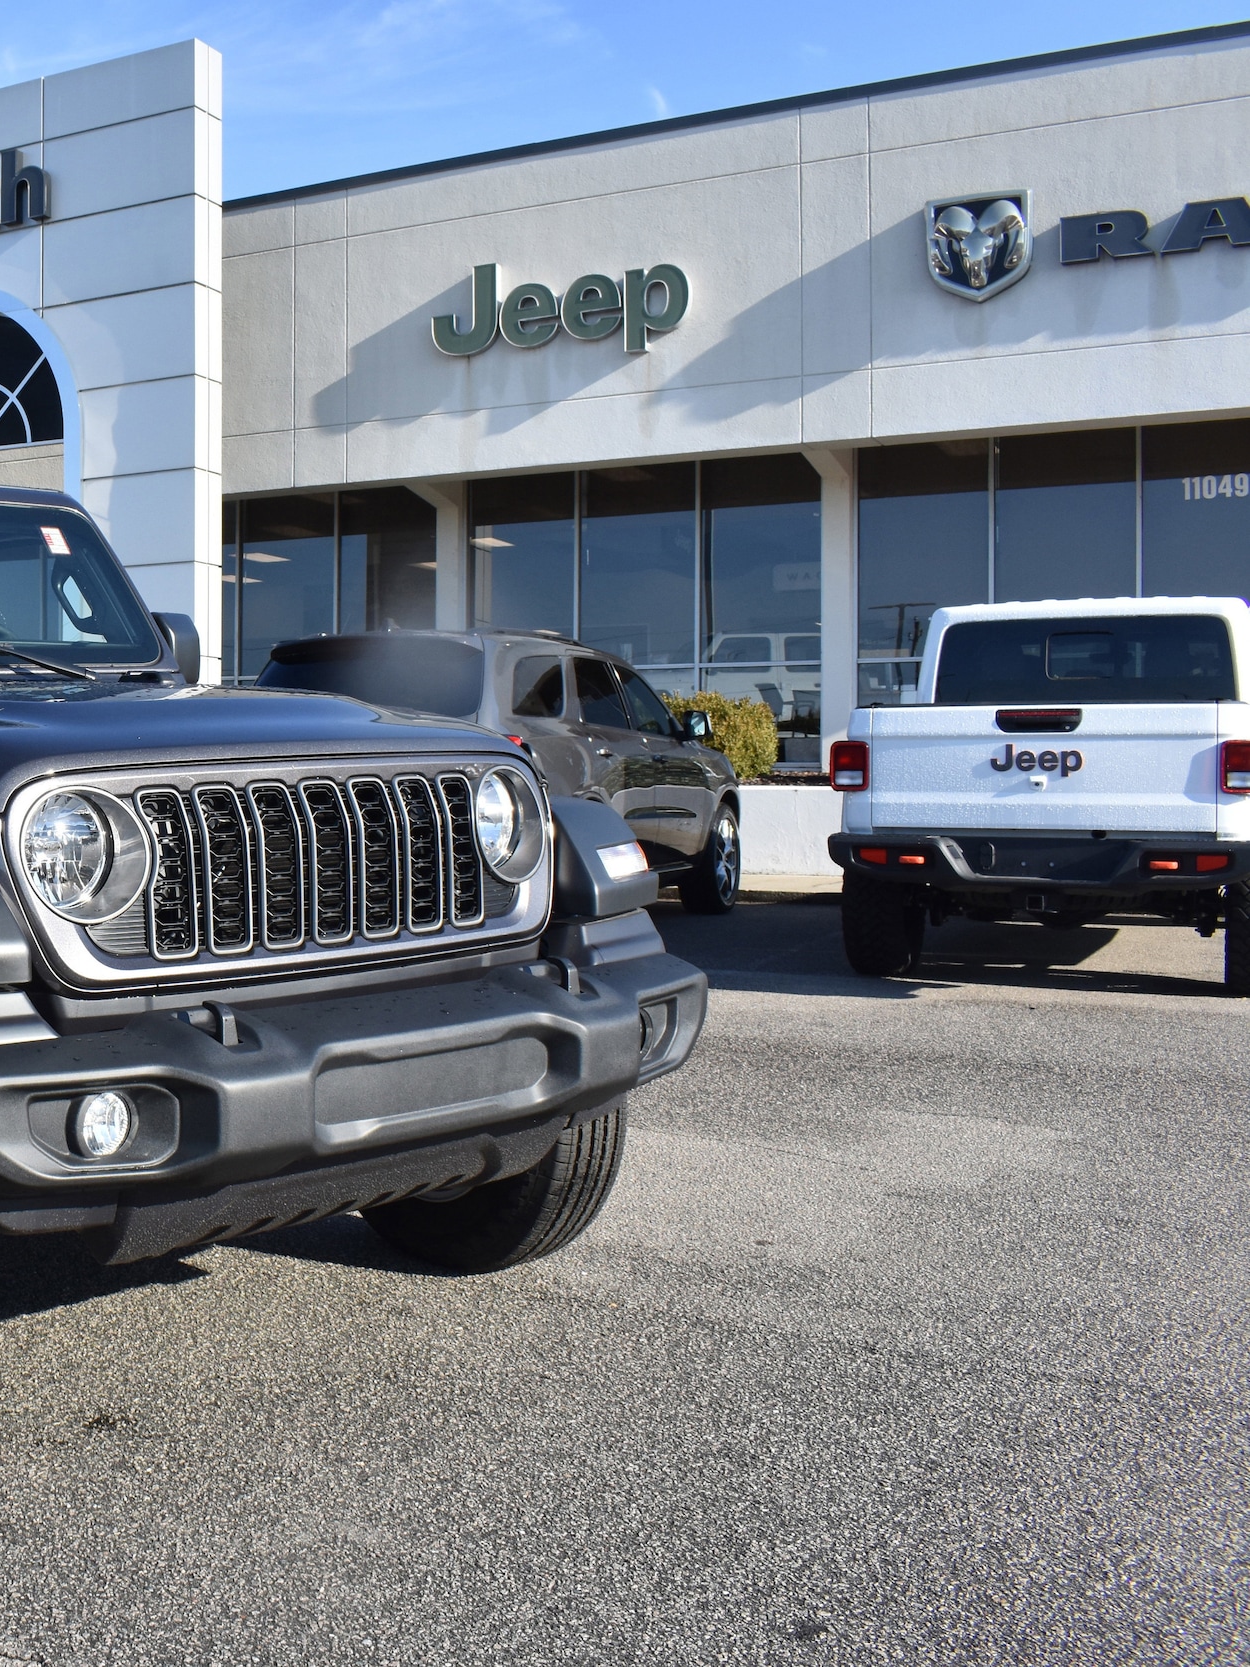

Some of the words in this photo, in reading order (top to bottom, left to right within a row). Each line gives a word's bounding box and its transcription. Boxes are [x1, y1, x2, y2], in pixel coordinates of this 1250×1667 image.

[431, 262, 693, 357] Jeep
[1182, 473, 1249, 500] 11049
[990, 743, 1084, 777] Jeep
